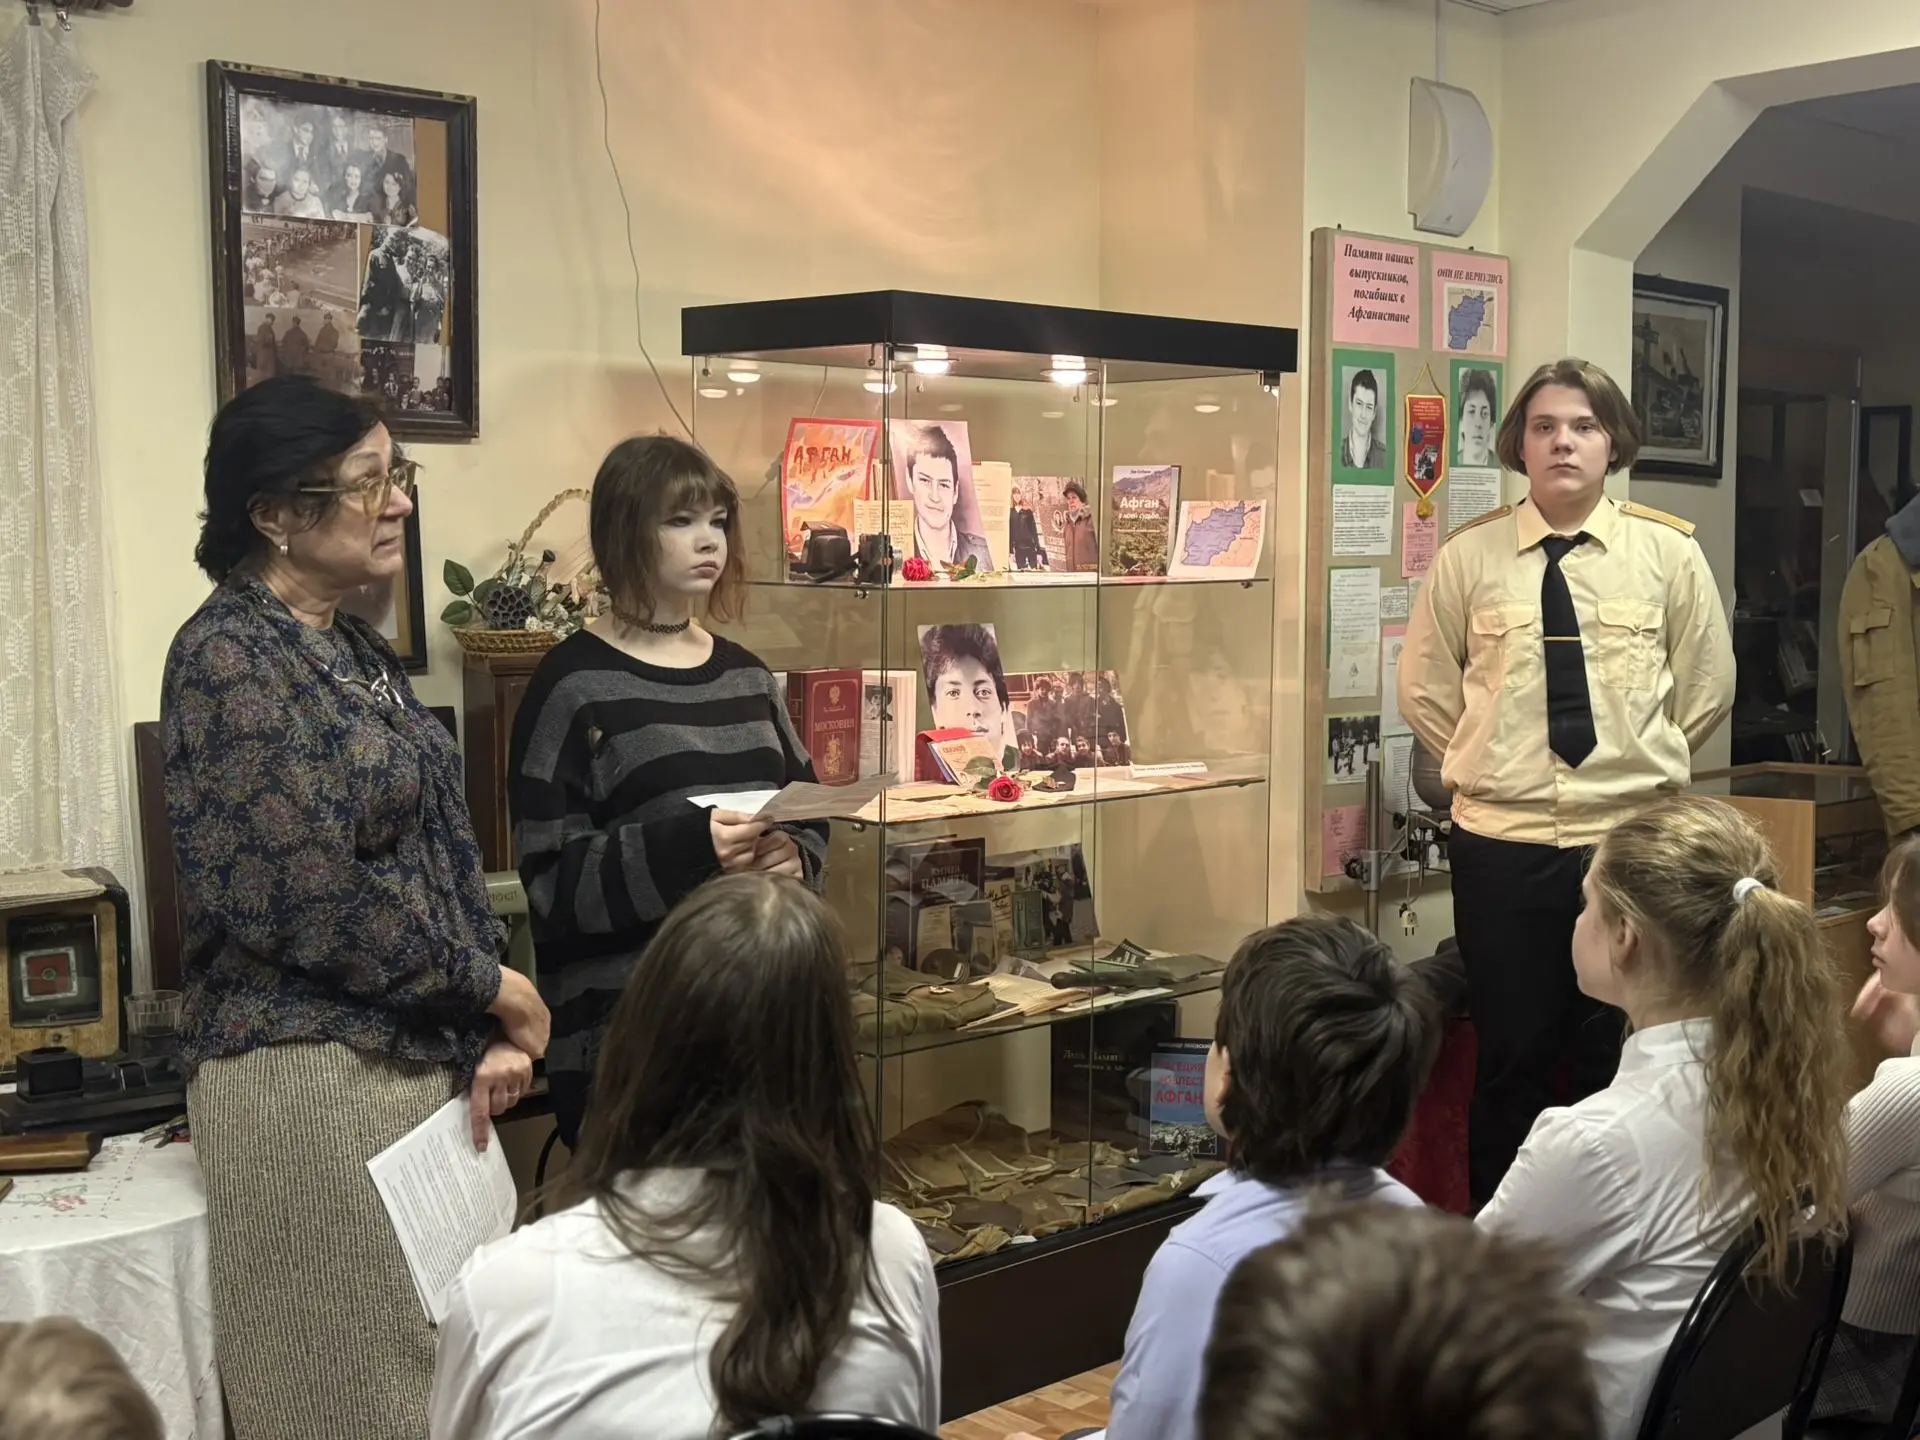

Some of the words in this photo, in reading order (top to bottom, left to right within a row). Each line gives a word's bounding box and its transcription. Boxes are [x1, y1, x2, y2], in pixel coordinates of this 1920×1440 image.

[1344, 243, 1383, 261] Памяти
[1385, 252, 1414, 265] наших
[1349, 268, 1409, 285] выпускников,
[1437, 268, 1453, 279] ОНИ
[1453, 269, 1464, 280] НЕ
[1465, 271, 1504, 284] ВЕРНУЛИСЬ
[1353, 287, 1399, 303] погибших
[1400, 294, 1406, 303] в
[1347, 305, 1411, 323] Афганистане
[1120, 496, 1159, 511] Афган
[1156, 1090, 1206, 1105] АФГАН
